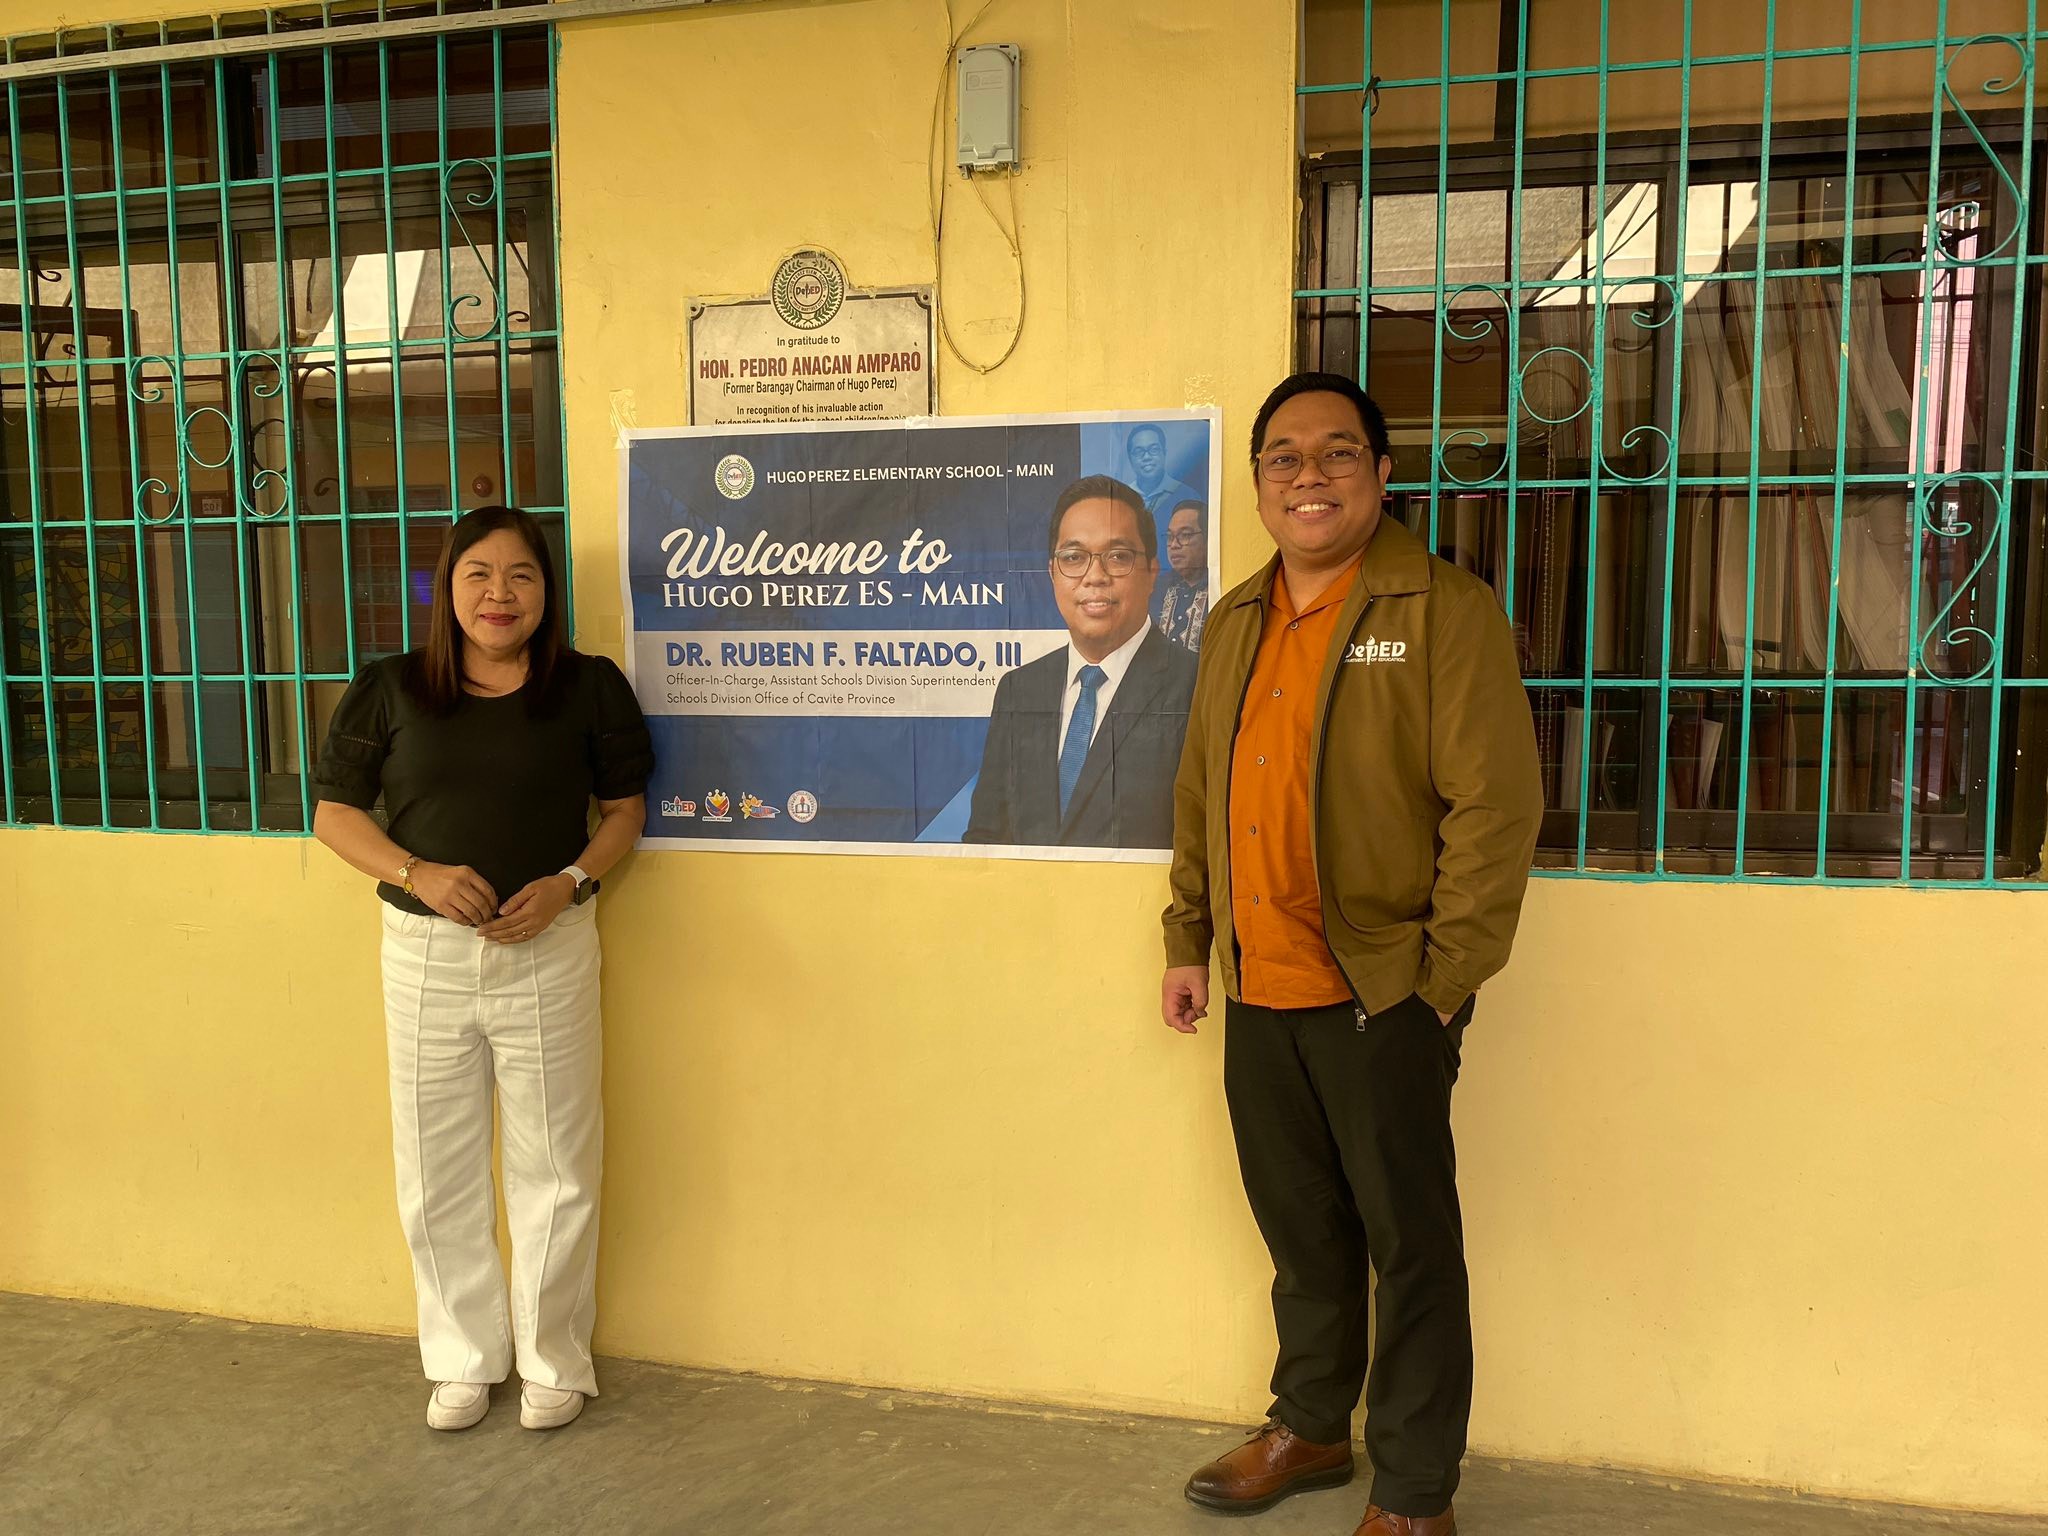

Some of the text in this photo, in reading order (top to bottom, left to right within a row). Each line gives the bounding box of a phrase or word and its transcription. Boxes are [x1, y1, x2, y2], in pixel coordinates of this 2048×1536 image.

[777, 336, 840, 348] In gratitude to
[700, 352, 921, 379] HON. PEDRO ANACAN AMPARO
[723, 376, 897, 396] (Former Barangay Chairman of Hugo Perez)
[736, 401, 884, 416] In recognition of his invaluable action
[766, 471, 806, 484] HUGO
[808, 470, 850, 482] PEREZ
[853, 466, 942, 481] ELEMENTARY
[945, 465, 1004, 479] SCHOOL
[1016, 463, 1054, 477] MAIN
[661, 526, 952, 580] Welcome to
[662, 582, 752, 608] HUGO
[761, 582, 850, 608] PEREZ
[858, 581, 894, 607] ES
[920, 580, 1004, 606] MAIN
[666, 641, 1021, 672] DR. RUBEN F. FALTADO, III
[666, 673, 996, 689] Officer-In-Charge, Assistant Schools Division Superintendent
[666, 691, 895, 704] Schools Division Office of Cavite Province
[662, 796, 695, 814] DepED
